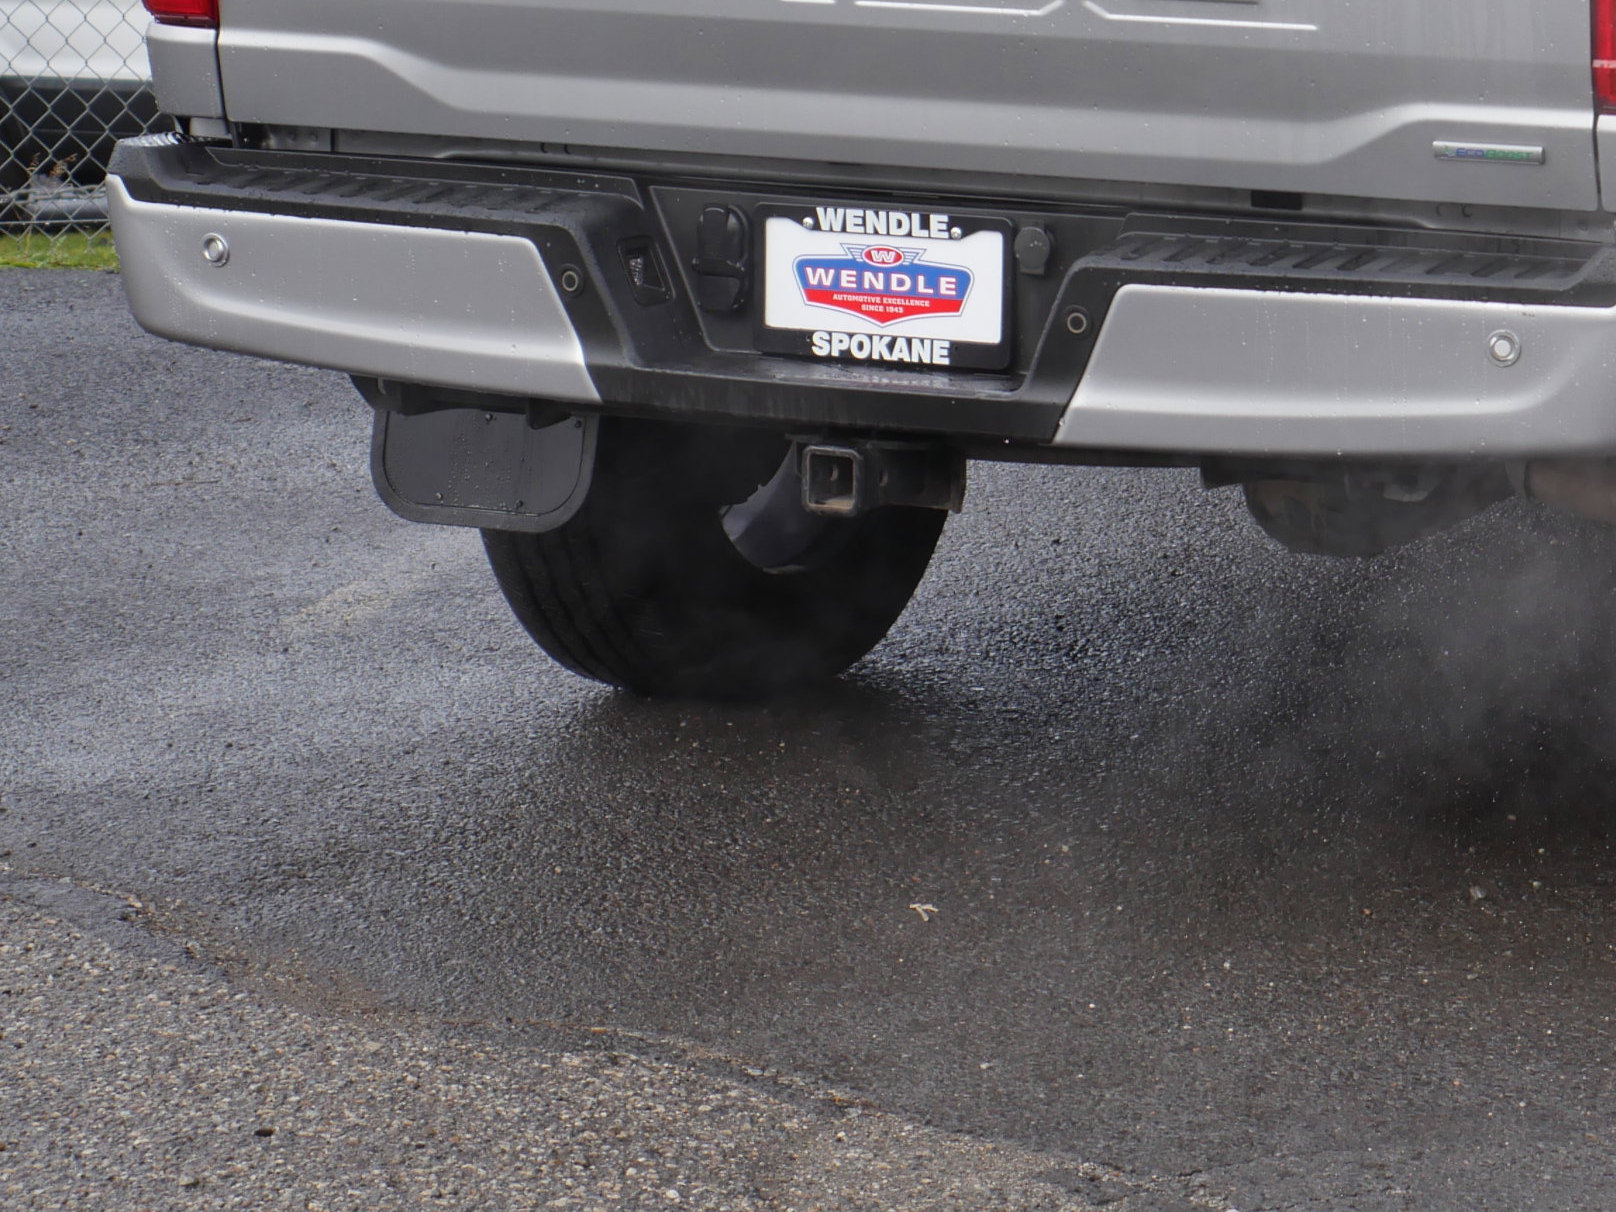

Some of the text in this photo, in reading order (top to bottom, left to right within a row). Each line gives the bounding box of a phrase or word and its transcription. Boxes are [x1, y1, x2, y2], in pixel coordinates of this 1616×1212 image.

[815, 206, 950, 239] WENDLE
[805, 268, 957, 295] WENDLE
[832, 293, 930, 307] AUTOMOTIVE EXCELLENCE
[861, 304, 884, 313] SINCE
[811, 330, 950, 365] SPOKANE
